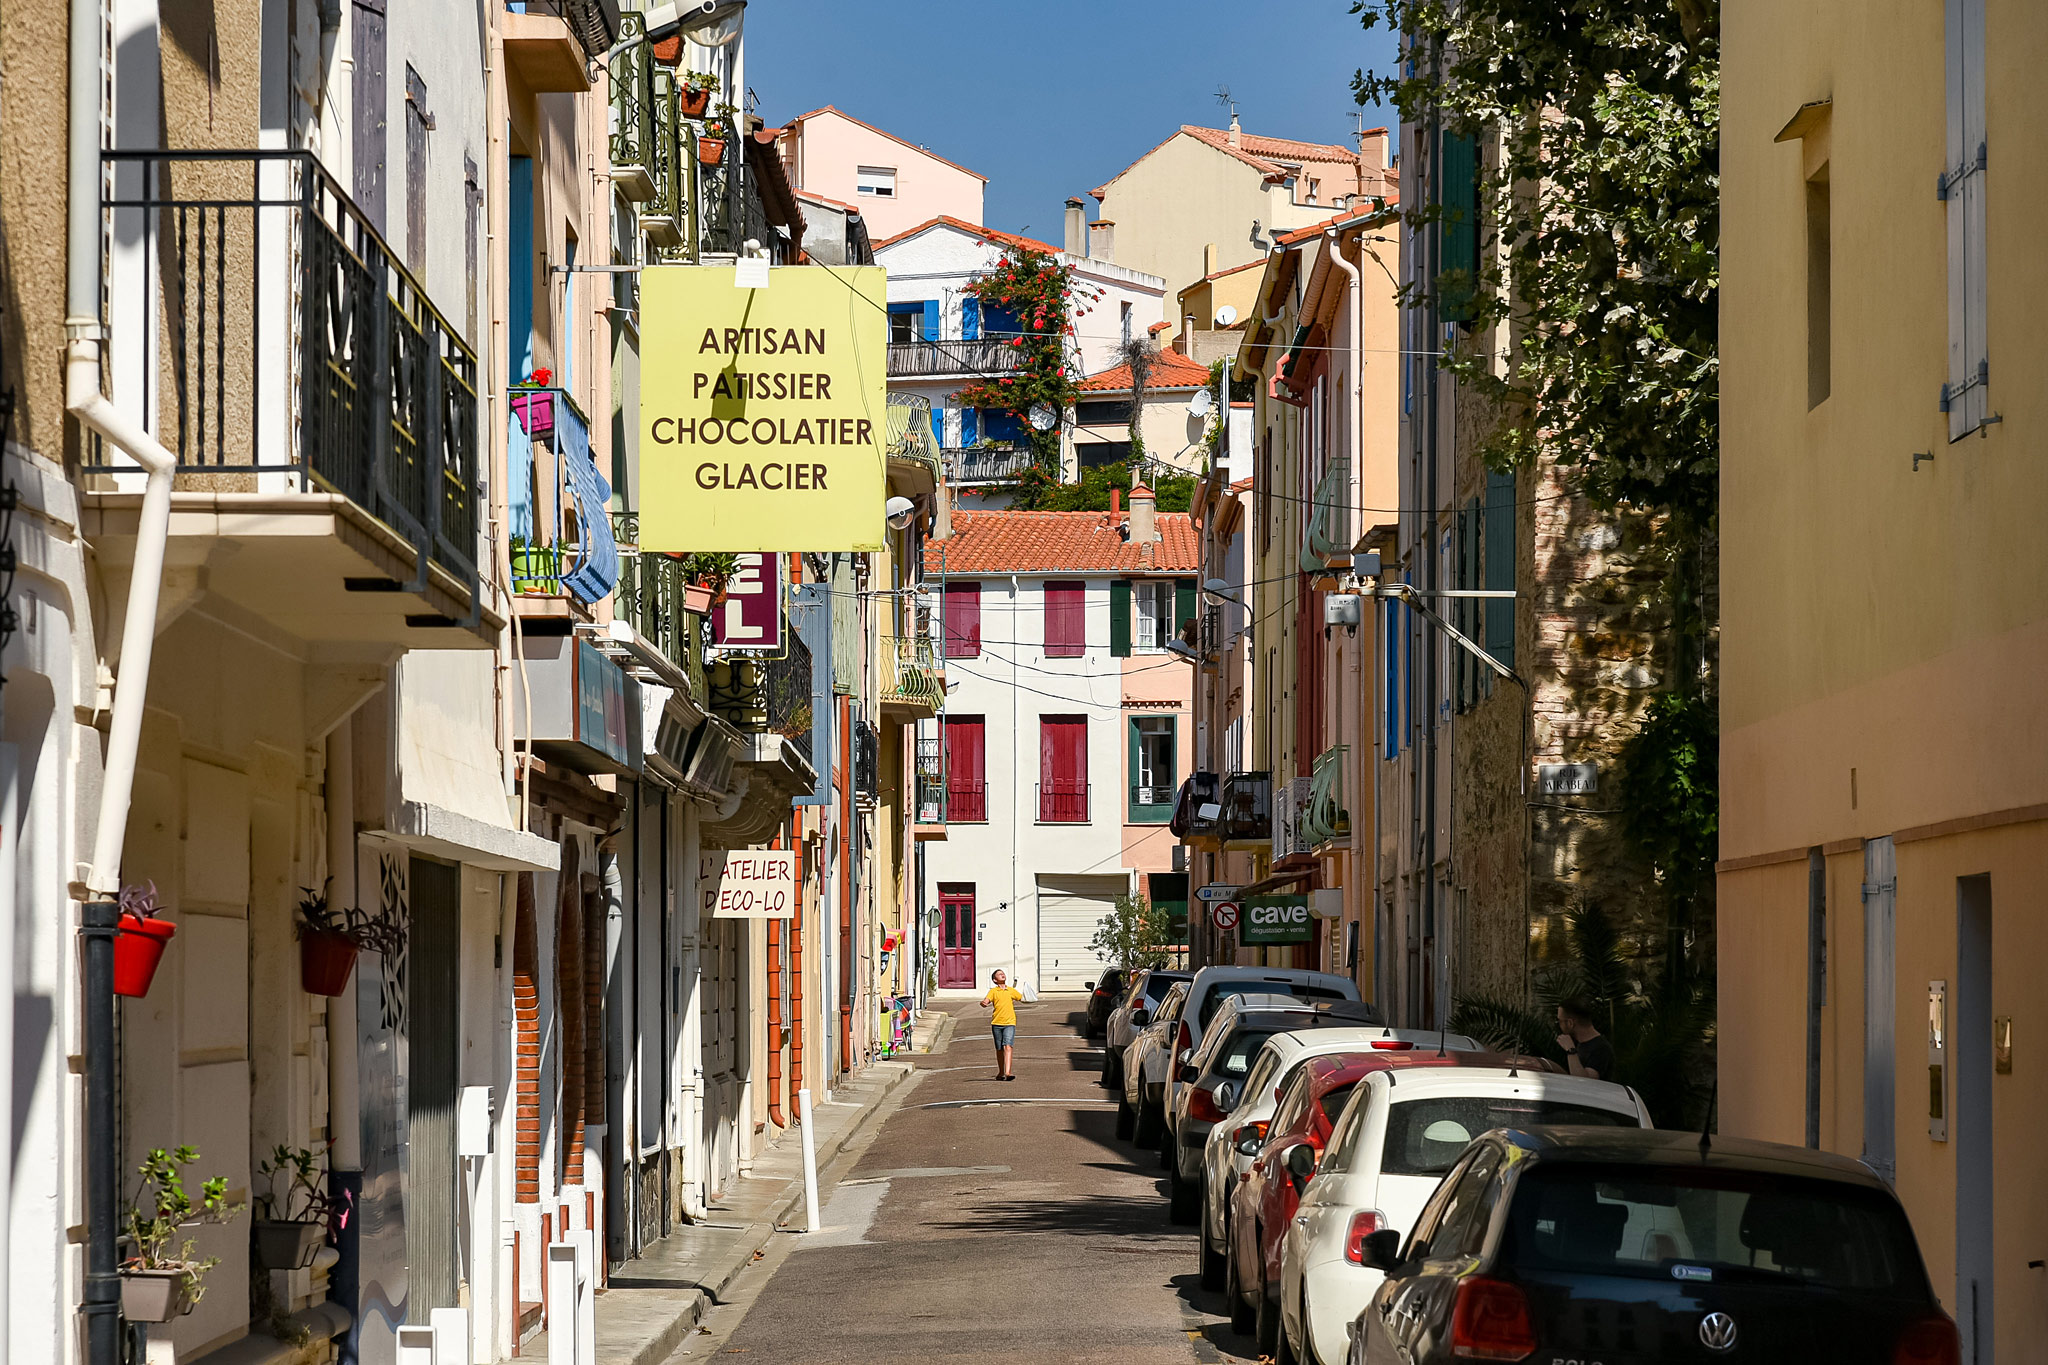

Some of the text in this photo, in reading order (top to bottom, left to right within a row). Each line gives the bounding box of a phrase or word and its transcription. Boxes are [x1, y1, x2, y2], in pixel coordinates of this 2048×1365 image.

[698, 328, 825, 355] ARTISAN
[693, 373, 832, 400] PATISSIER
[651, 417, 872, 445] CHOCOLATIER
[695, 462, 828, 490] GLACIER
[1544, 779, 1596, 790] MIRABEAU
[1559, 769, 1578, 778] RUE
[1250, 905, 1308, 924] cave
[1250, 927, 1286, 935] dégustation
